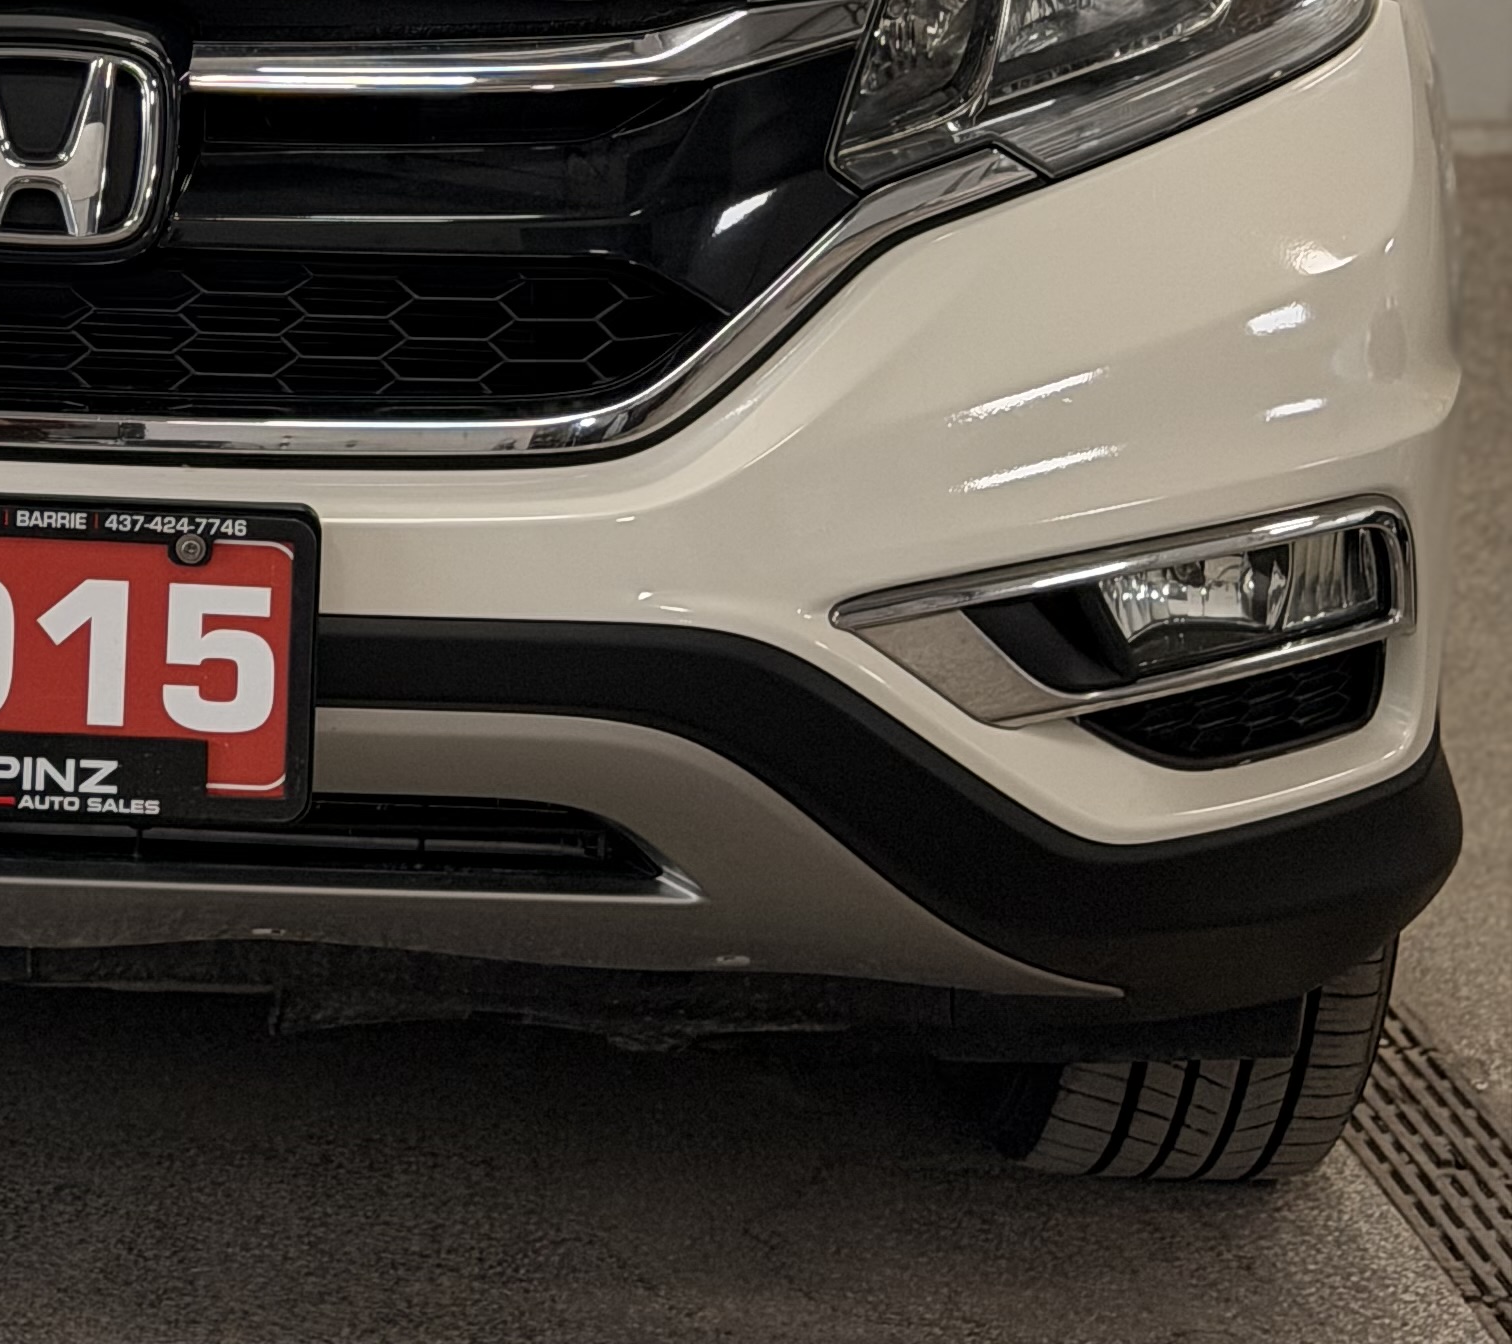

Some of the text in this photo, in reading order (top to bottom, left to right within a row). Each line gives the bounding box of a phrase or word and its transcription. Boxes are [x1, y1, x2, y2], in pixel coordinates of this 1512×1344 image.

[16, 510, 87, 530] BARRIE
[104, 514, 247, 536] 437-424-7746
[18, 795, 160, 815] AUTO SALES
